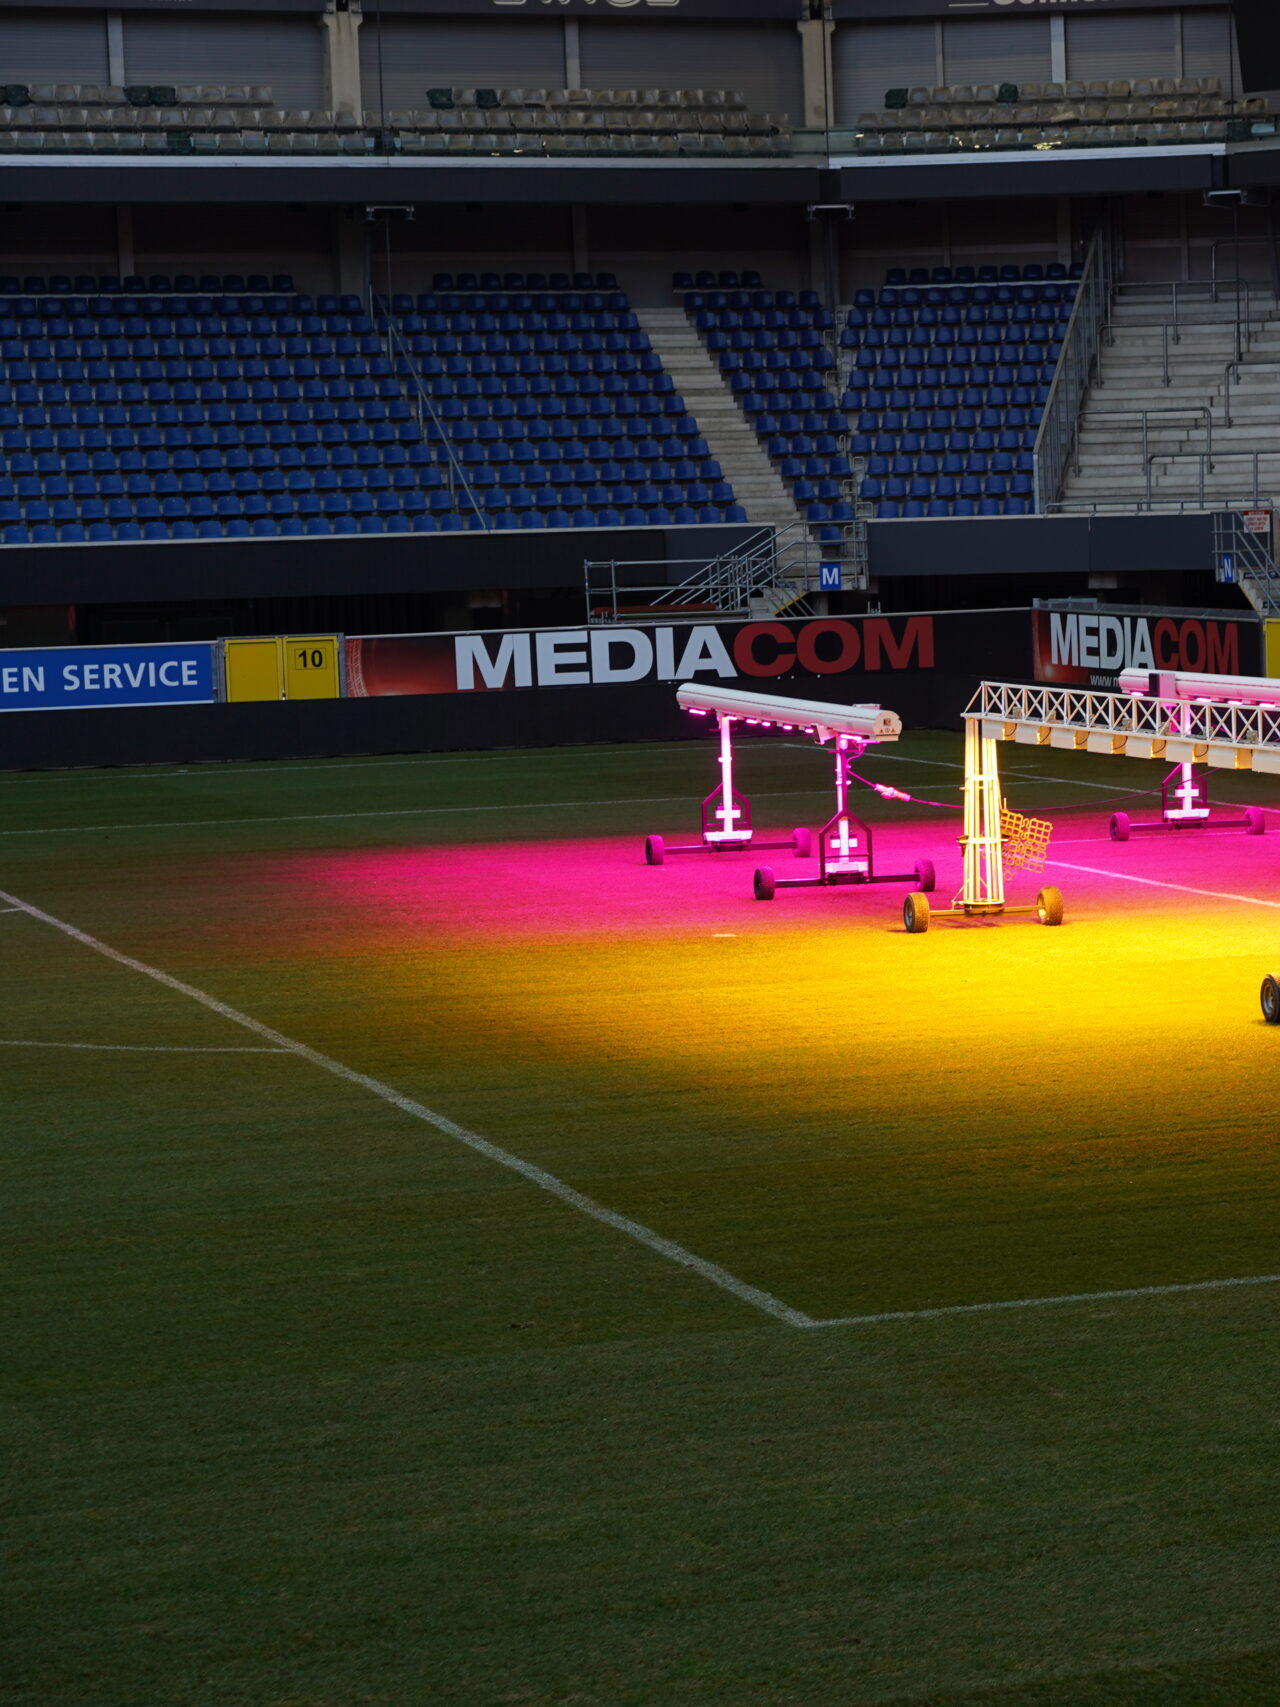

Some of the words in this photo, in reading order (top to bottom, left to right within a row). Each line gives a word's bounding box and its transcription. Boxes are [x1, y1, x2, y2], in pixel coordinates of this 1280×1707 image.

[822, 567, 839, 585] M
[1223, 558, 1232, 579] N
[454, 616, 935, 690] MEDIACOM
[1050, 612, 1240, 676] MEDIACOM
[298, 649, 323, 668] 10
[2, 666, 46, 693] EN
[62, 660, 199, 692] SERVICE
